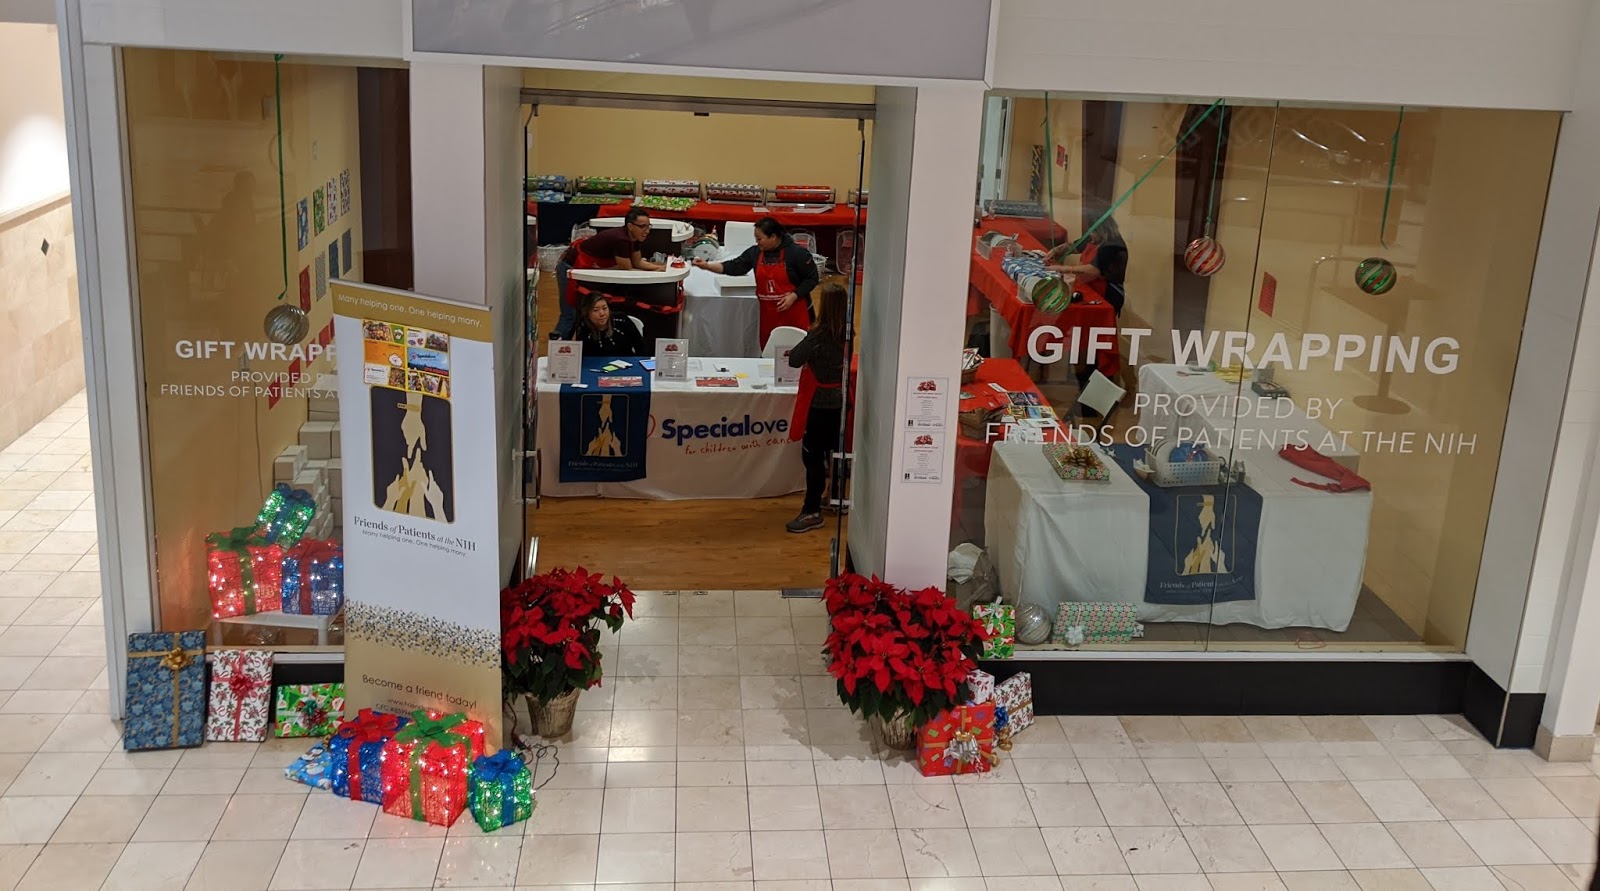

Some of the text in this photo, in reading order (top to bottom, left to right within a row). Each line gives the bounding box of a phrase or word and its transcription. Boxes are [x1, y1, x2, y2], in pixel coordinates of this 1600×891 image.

[338, 294, 482, 328] Many helping one. One helping many.
[175, 340, 337, 362] GIFT WRAPP
[1027, 325, 1460, 375] GIFT WRAPPING
[161, 384, 225, 397] FRIENDS
[229, 386, 250, 397] OF
[255, 386, 321, 399] PATIENTS
[231, 371, 311, 384] PROVIDED
[1133, 393, 1343, 420] PROVIDED BY
[661, 414, 788, 446] Specialove
[985, 422, 1477, 455] FRIENDS OF PATIENTS AT THE NIH
[685, 438, 792, 455] for children with canc
[354, 516, 389, 532] Friends
[390, 525, 398, 534] of
[398, 524, 436, 541] Patients
[455, 537, 476, 551] NIH
[362, 674, 477, 710] Become a friend today!
